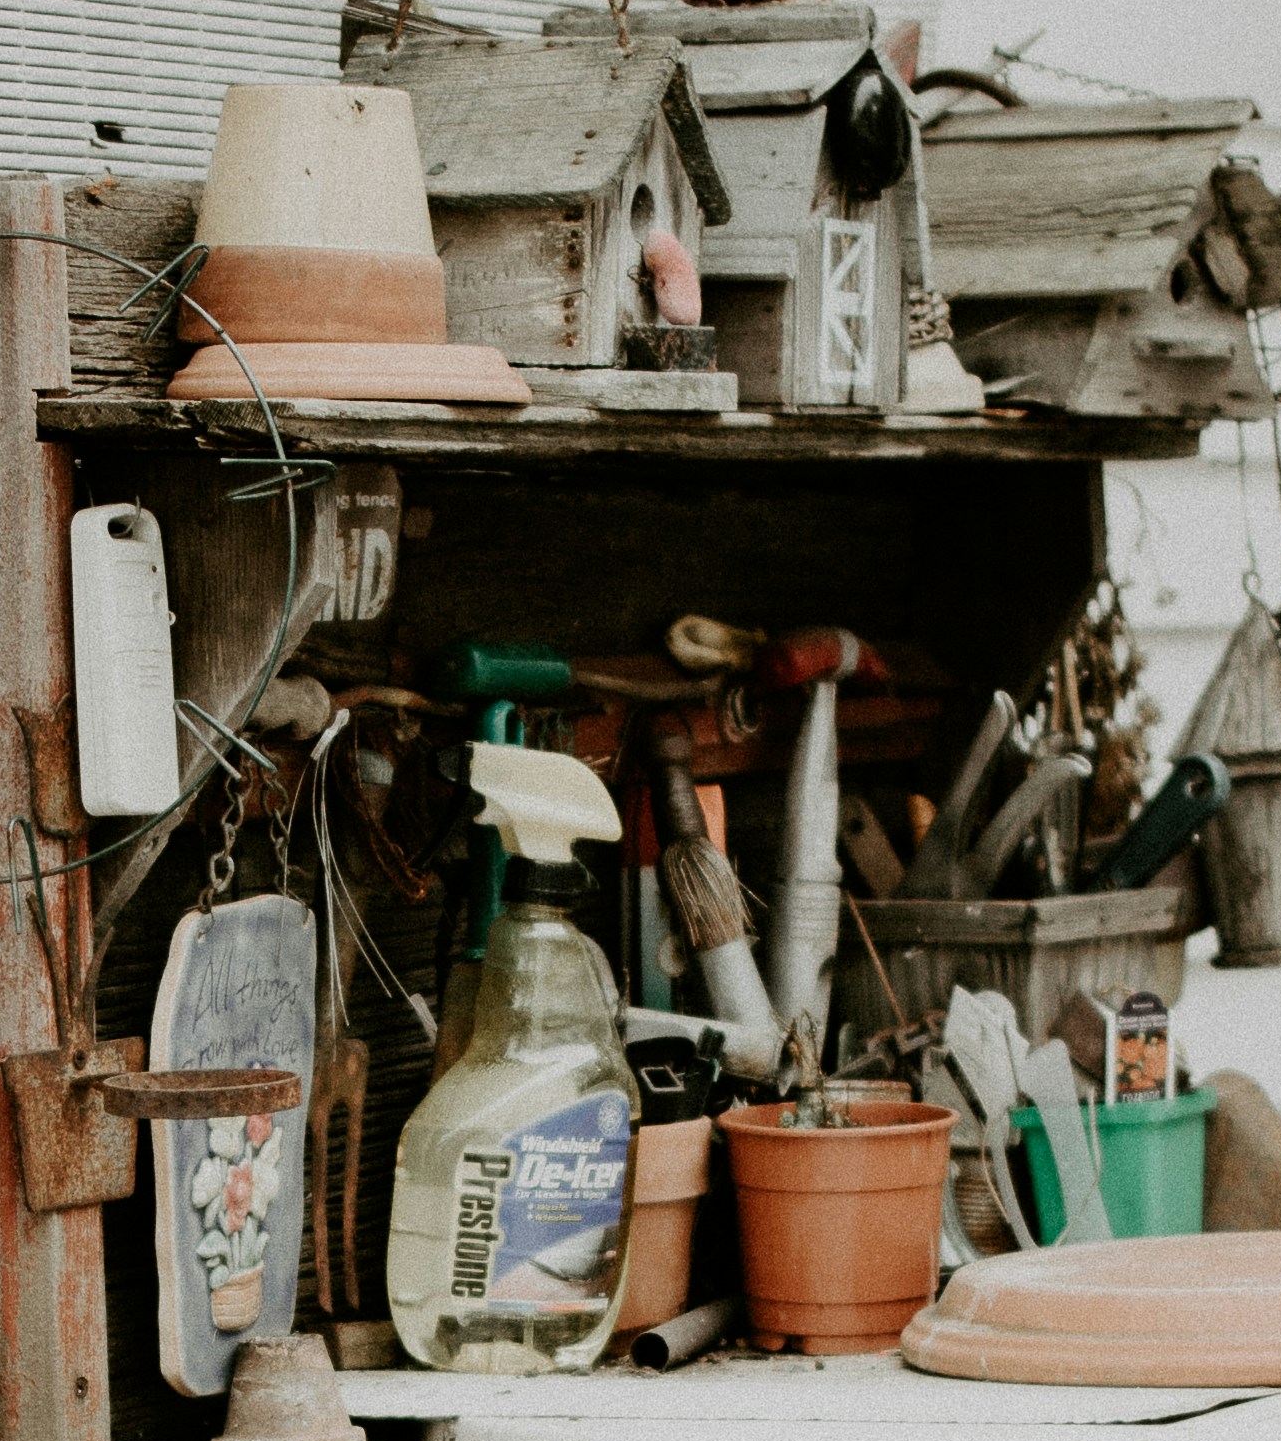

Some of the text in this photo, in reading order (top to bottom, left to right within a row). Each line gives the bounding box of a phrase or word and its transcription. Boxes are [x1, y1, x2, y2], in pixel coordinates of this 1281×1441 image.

[314, 527, 393, 622] ND
[517, 1154, 624, 1188] De-Icer
[521, 1135, 604, 1154] Windshield
[451, 1152, 512, 1299] Prestone
